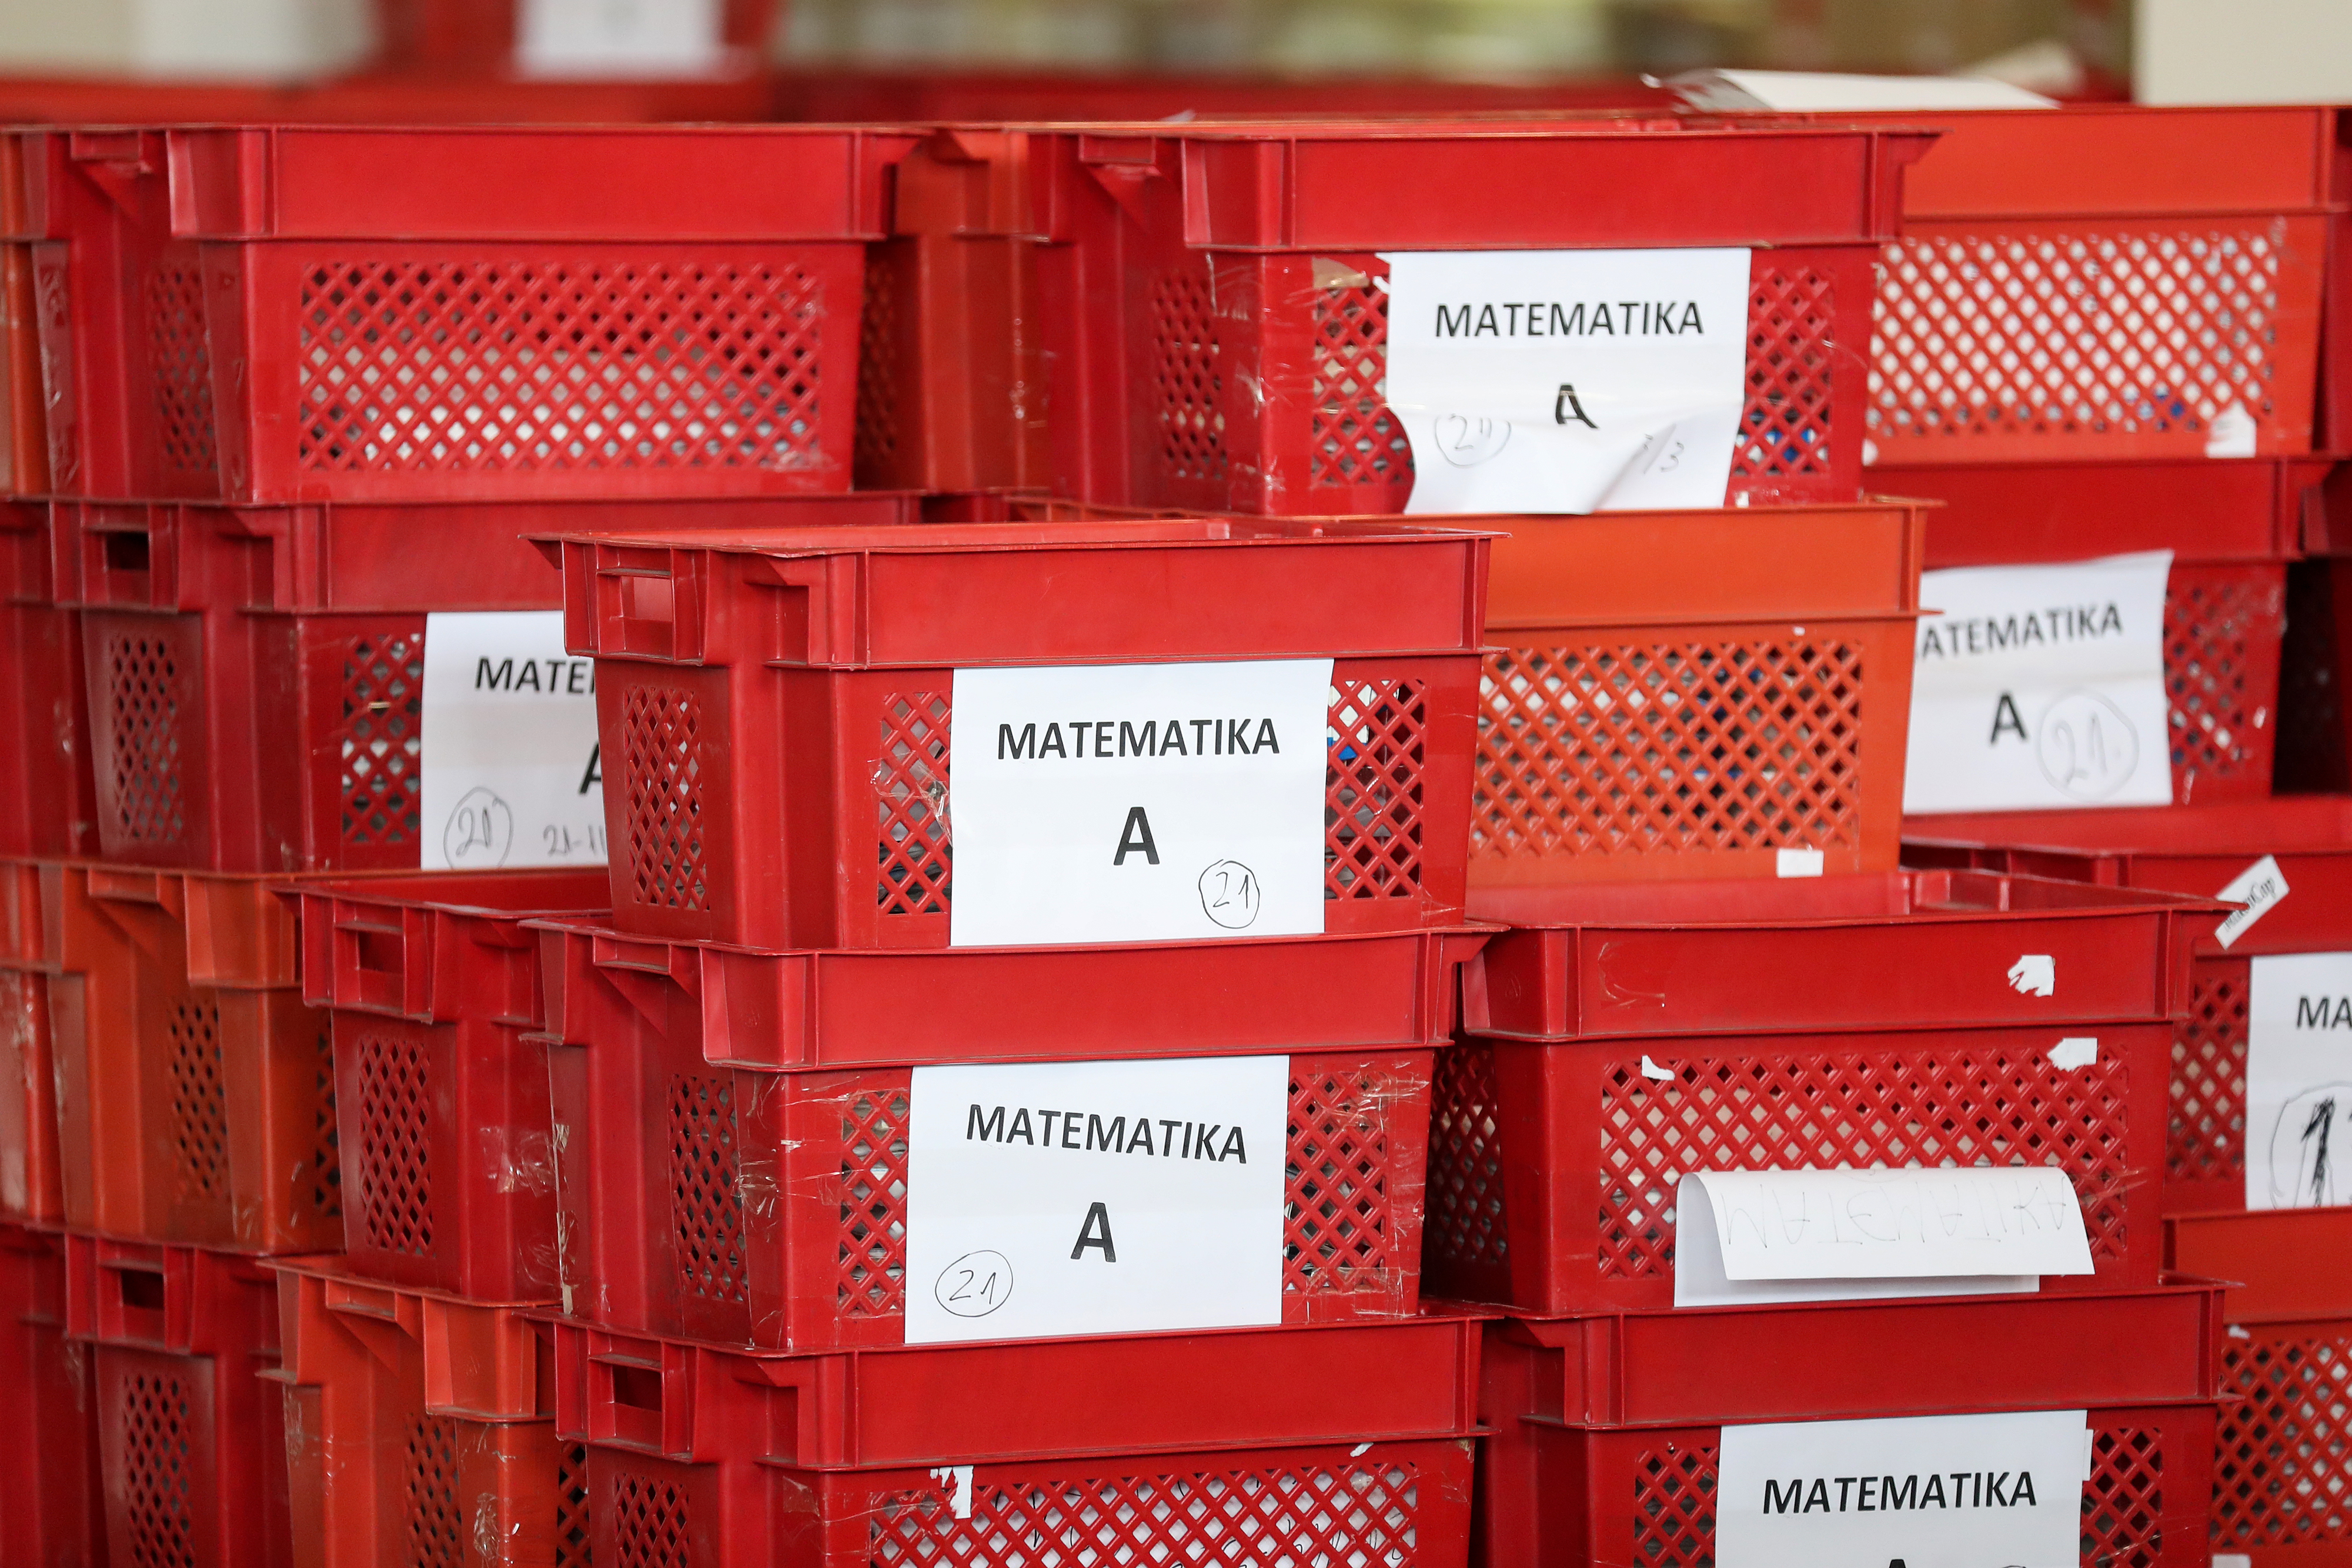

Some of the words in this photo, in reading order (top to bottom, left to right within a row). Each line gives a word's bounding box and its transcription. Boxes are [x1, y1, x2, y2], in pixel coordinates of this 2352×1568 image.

[1435, 302, 1704, 337] MATEMATIKA
[1555, 383, 1599, 429] A
[1917, 602, 2123, 660] ATEMATIKA
[998, 718, 1280, 760] MATEMATIKA
[1990, 691, 2028, 747] A
[1113, 806, 1160, 866] A
[1212, 871, 1250, 910] 21
[966, 1104, 1247, 1164] MATEMATIKA
[1070, 1202, 1117, 1263] A
[948, 1269, 997, 1305] 21
[1763, 1471, 2037, 1514] MATEMATIKA
